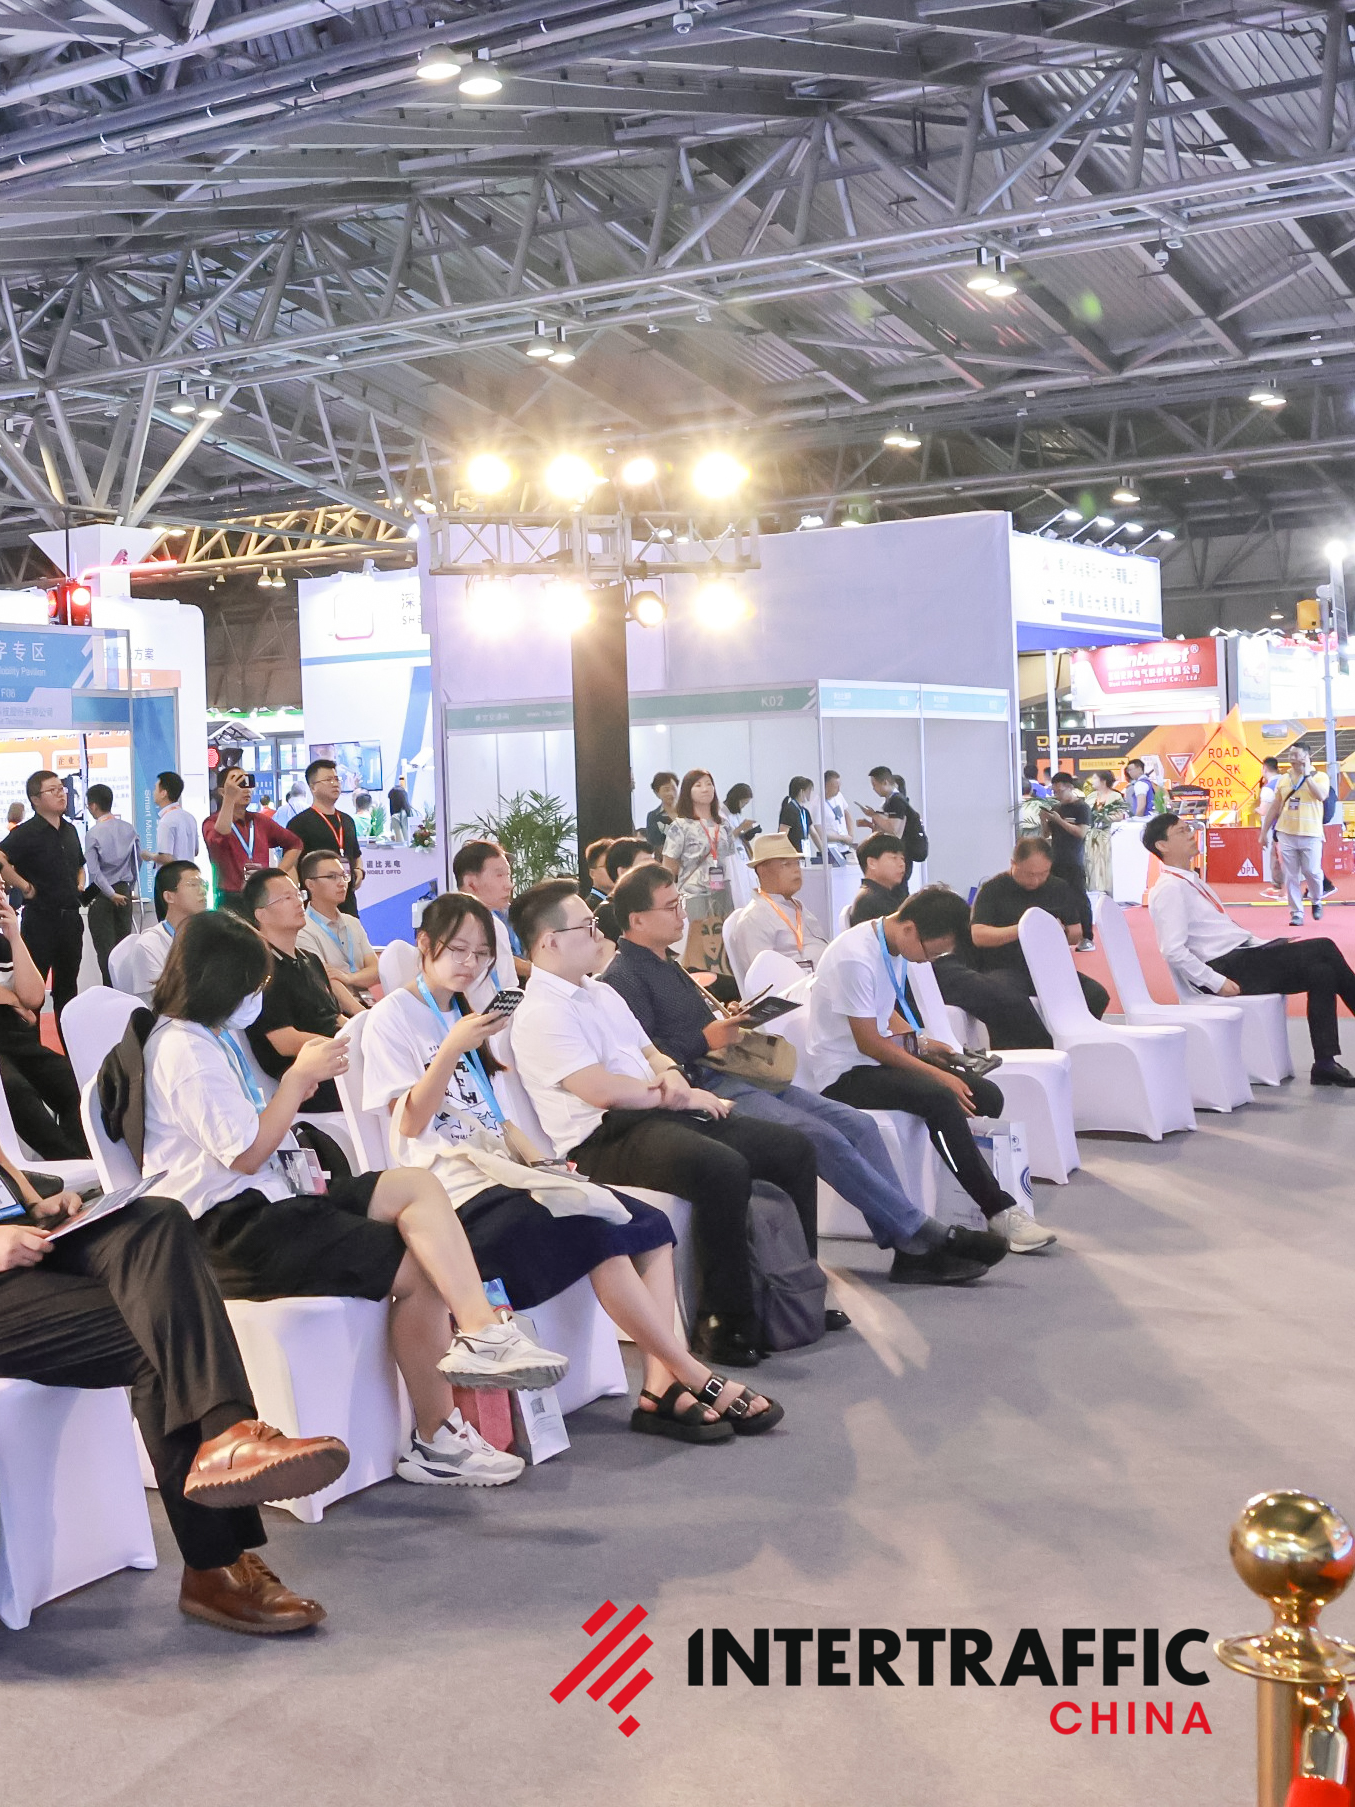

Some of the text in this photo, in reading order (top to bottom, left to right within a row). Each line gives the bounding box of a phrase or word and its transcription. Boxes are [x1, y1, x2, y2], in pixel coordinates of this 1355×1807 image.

[21, 666, 46, 677] Pavilion
[760, 695, 784, 708] K02
[1036, 732, 1130, 747] OTRAFFIC
[1208, 746, 1240, 759] ROAD
[1198, 777, 1232, 788] ROAD
[1209, 800, 1238, 811] HEAD
[144, 789, 154, 893] Smart Mobilit avilion
